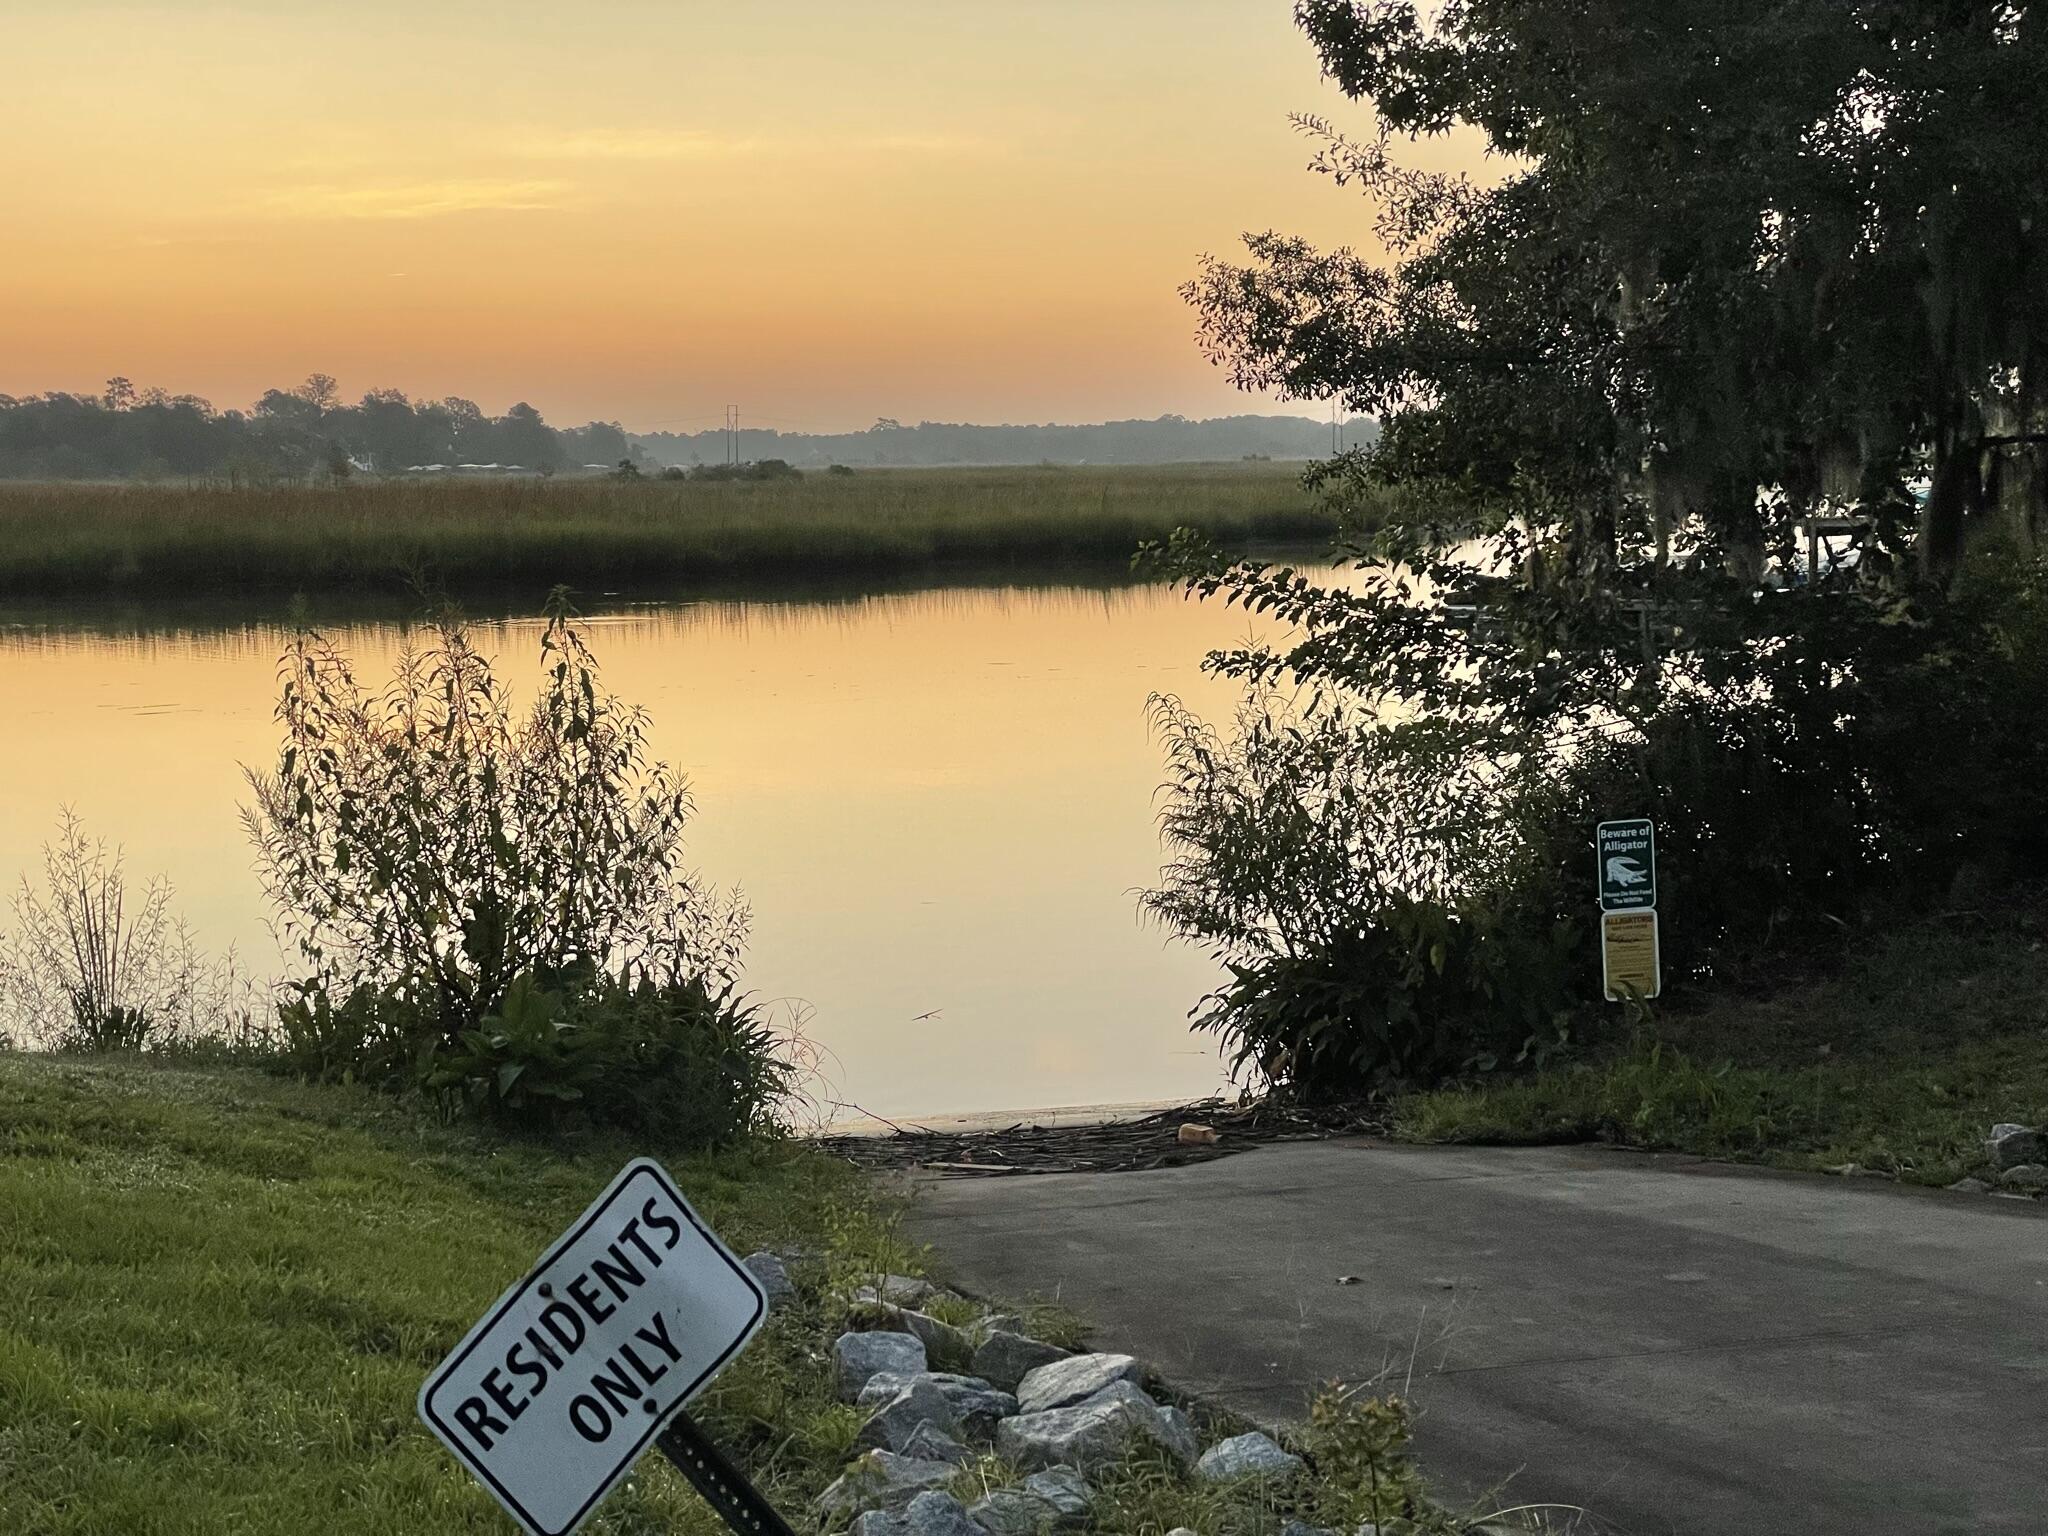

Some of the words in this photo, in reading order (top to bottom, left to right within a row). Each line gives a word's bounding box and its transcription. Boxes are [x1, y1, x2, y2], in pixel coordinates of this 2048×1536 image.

[1600, 829, 1637, 839] Beware
[1639, 826, 1650, 836] of
[1604, 841, 1648, 852] Alligator
[453, 1197, 681, 1452] RESIDENTS
[569, 1311, 683, 1443] ONLY
